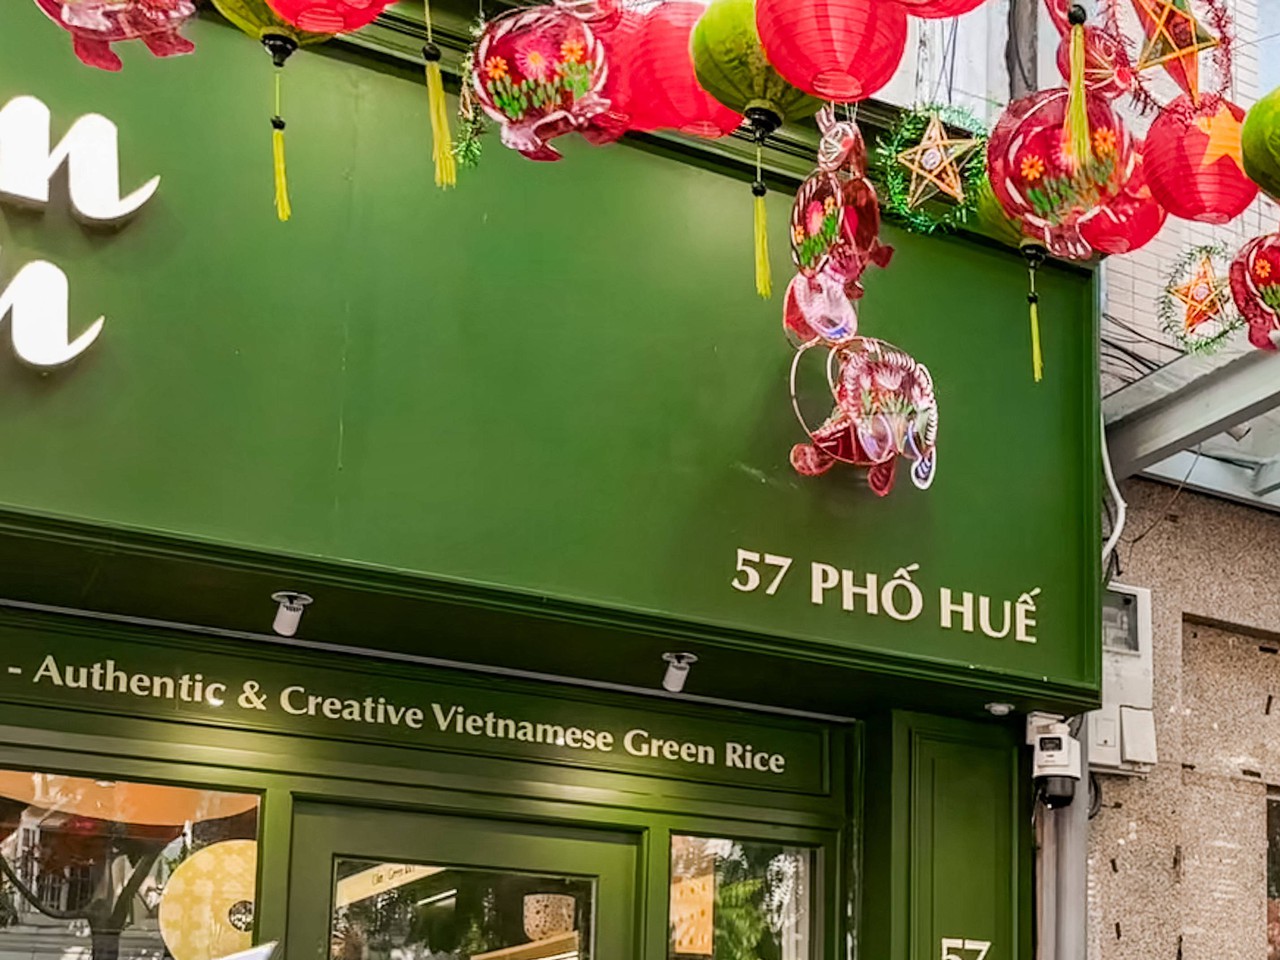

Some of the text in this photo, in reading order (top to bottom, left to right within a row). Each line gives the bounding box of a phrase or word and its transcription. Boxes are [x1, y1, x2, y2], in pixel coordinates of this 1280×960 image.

[731, 548, 1042, 643] 57 PHỐ HUẾ
[33, 654, 227, 707] Authentic
[238, 680, 267, 711] &
[279, 686, 424, 729] Creative
[431, 703, 614, 751] Vietnamese
[623, 729, 714, 764] Green
[725, 742, 785, 774] Rice
